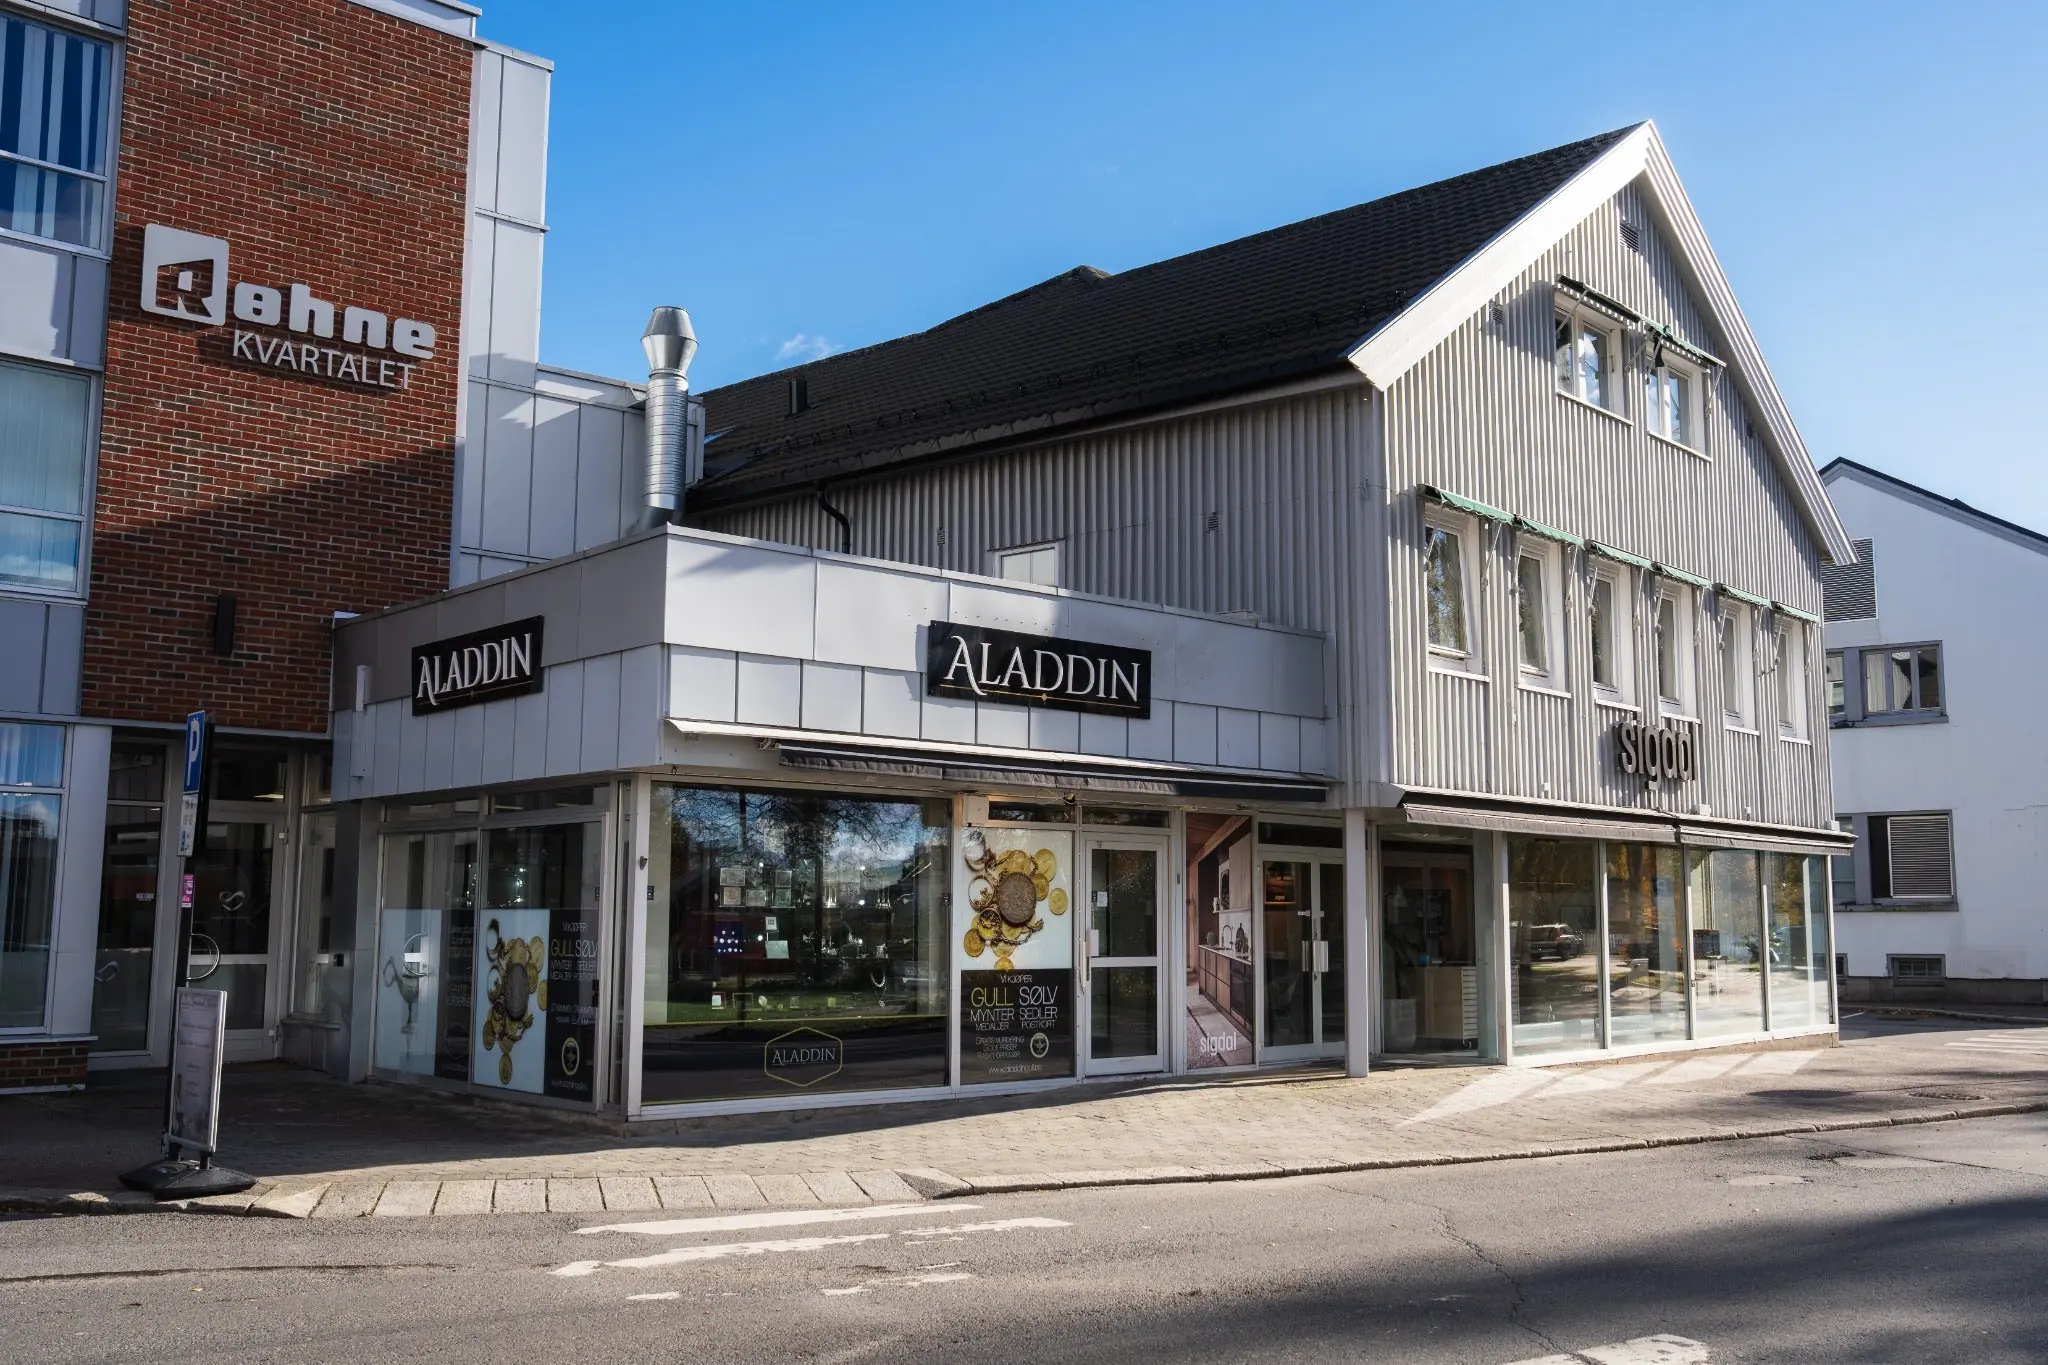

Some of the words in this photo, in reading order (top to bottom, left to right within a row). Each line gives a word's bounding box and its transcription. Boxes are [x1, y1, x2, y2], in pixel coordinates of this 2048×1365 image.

[233, 329, 416, 389] KVARTALET
[416, 633, 532, 705] ALADDIN
[943, 635, 1140, 702] ALADDIN
[186, 718, 199, 787] P
[1619, 717, 1698, 791] sigdal
[970, 1008, 1015, 1022] MYNTER
[1019, 1006, 1058, 1020] SEDLER
[971, 987, 1014, 1007] GULL
[1019, 985, 1059, 1006] SØLV
[772, 1047, 836, 1067] ALADDIN
[1200, 1031, 1237, 1056] sigdal
